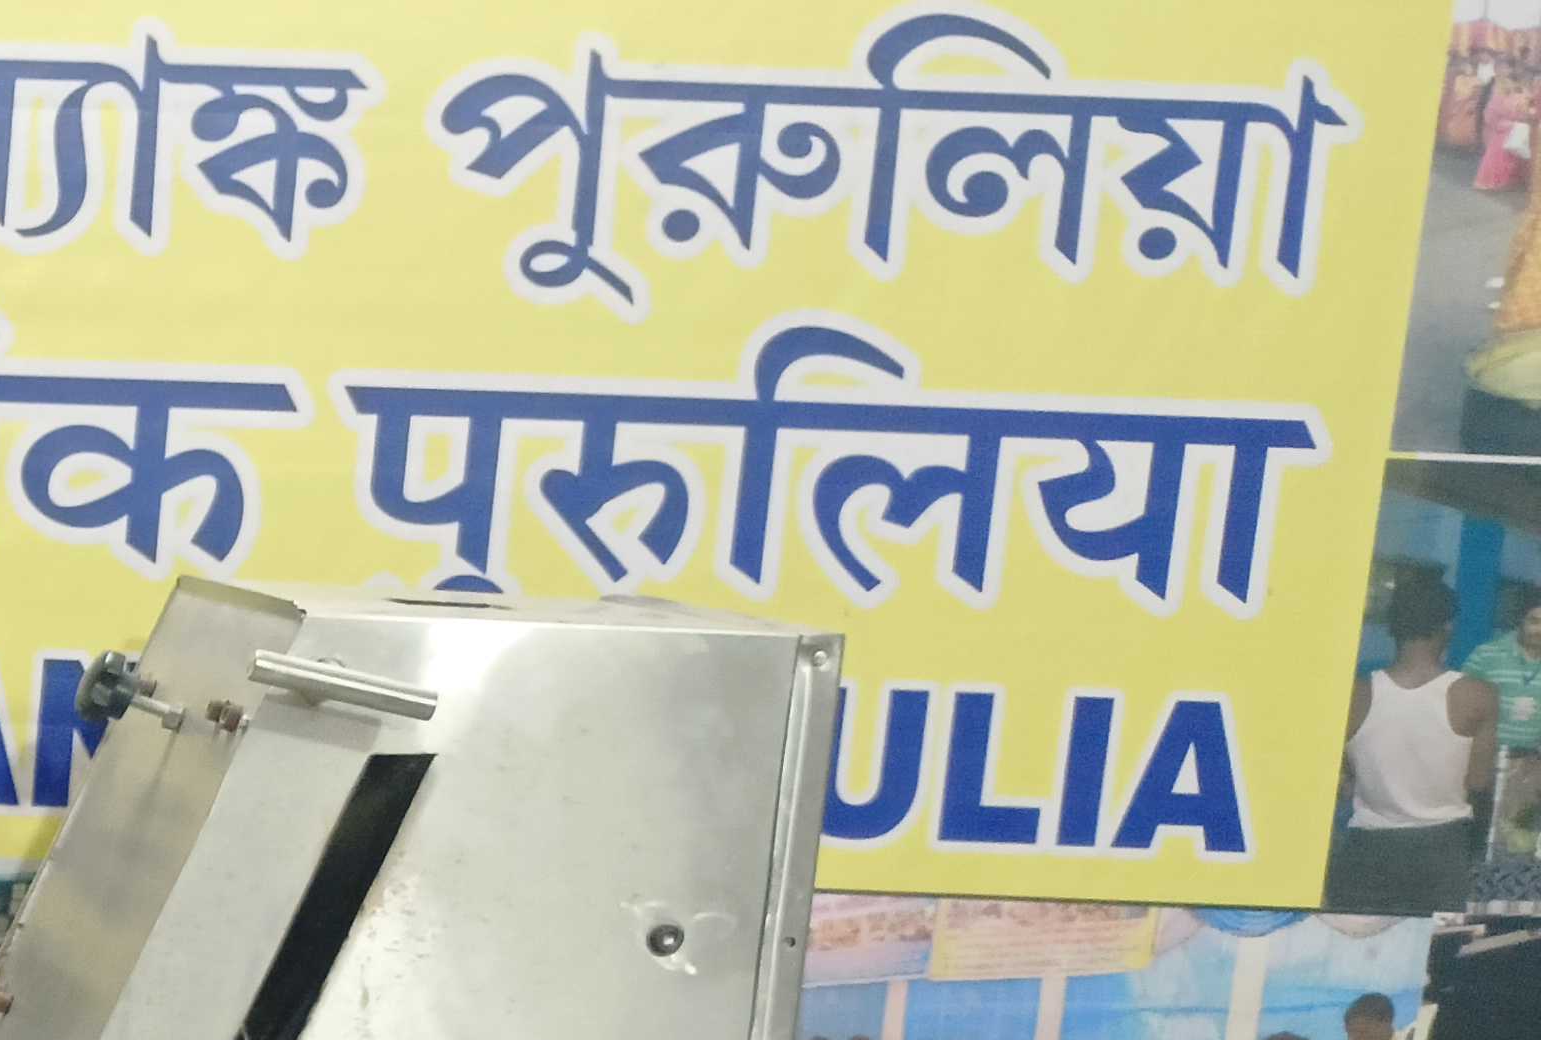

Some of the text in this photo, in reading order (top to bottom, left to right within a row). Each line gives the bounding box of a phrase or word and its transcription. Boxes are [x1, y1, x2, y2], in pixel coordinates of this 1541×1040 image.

[440, 13, 1348, 305] পুরুলিয়া
[345, 325, 1316, 604] परुलिया
[823, 686, 1247, 853] ULIA
